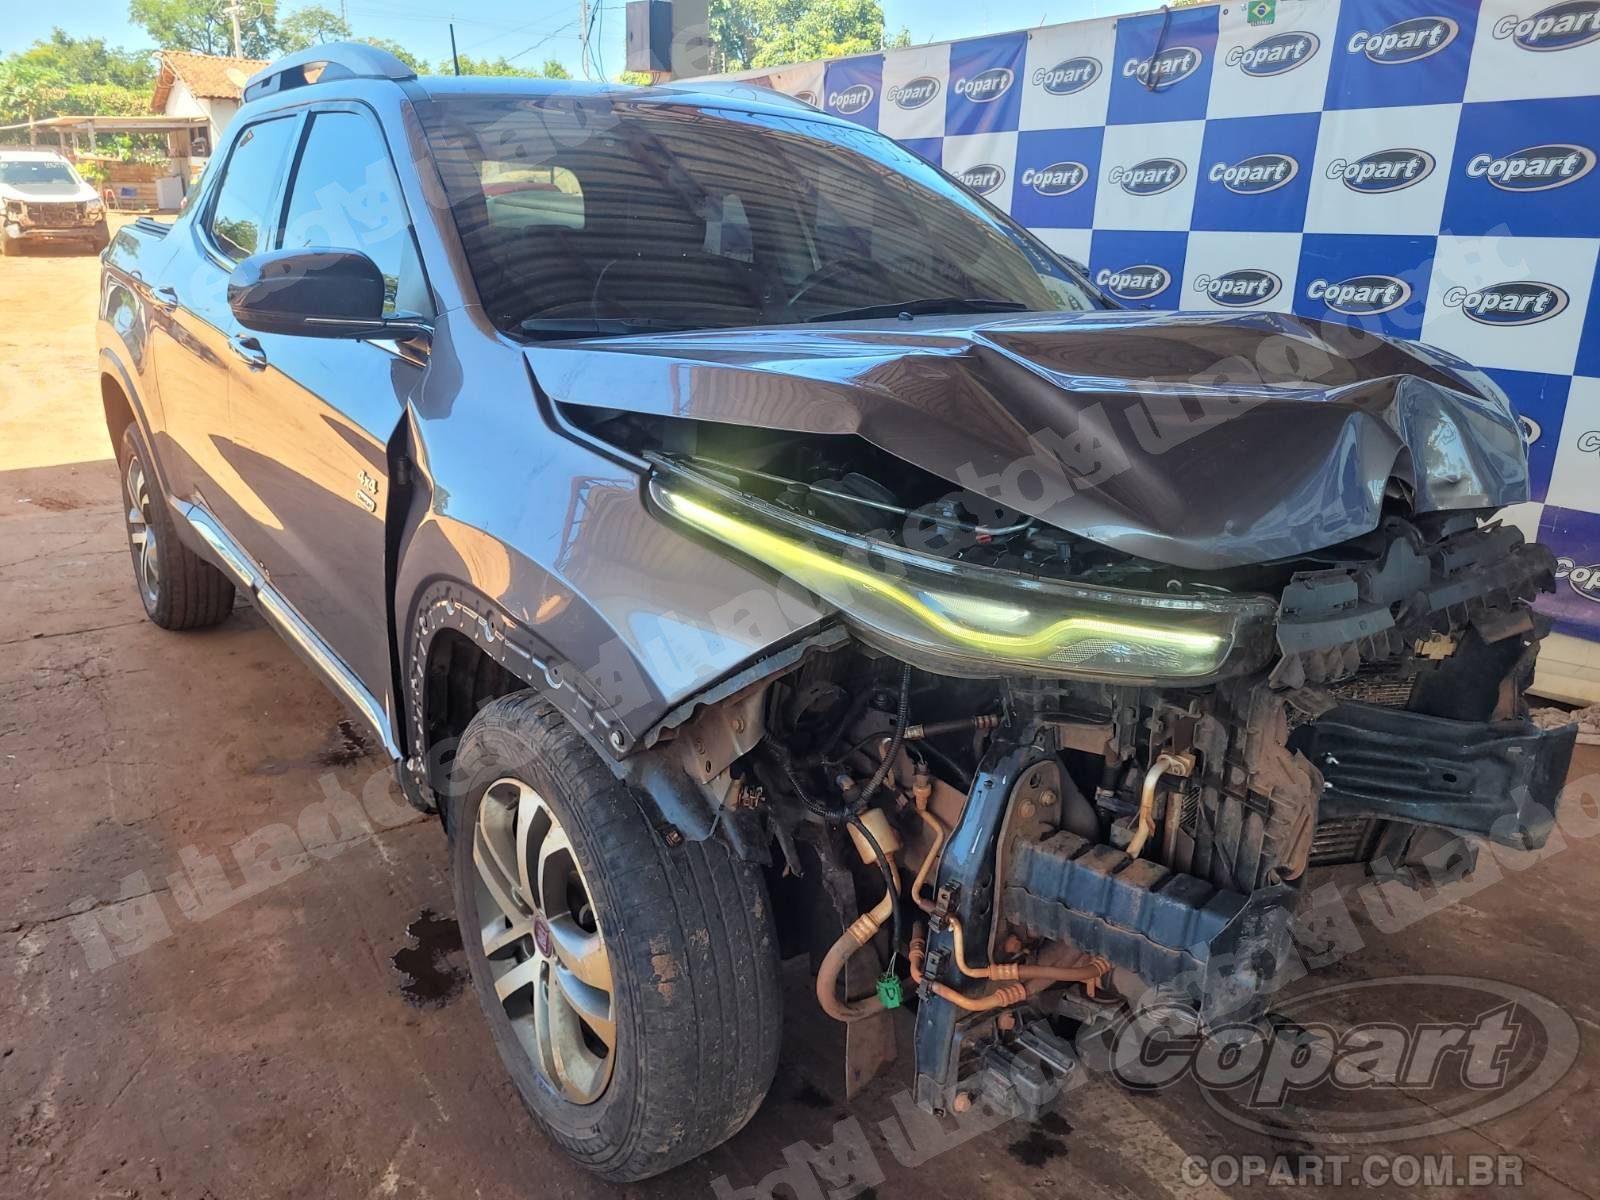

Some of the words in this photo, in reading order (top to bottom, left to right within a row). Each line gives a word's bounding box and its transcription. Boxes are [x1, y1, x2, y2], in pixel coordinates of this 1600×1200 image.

[1347, 24, 1443, 57] Copart
[1122, 53, 1190, 80] Copart
[1225, 42, 1304, 72] Copart
[954, 75, 1008, 99] Copart
[1032, 62, 1090, 88] Copart
[829, 90, 867, 109] Copart
[887, 82, 936, 105] Copart
[1022, 164, 1082, 190] Copart
[1109, 162, 1176, 190] Copart
[1209, 160, 1287, 185] Copart
[1326, 153, 1424, 183] Copart
[1466, 150, 1580, 183] Copart
[1096, 267, 1161, 293] Copart
[1193, 274, 1272, 298] Copart
[1307, 279, 1400, 305] Copart
[1443, 286, 1552, 316] Copart
